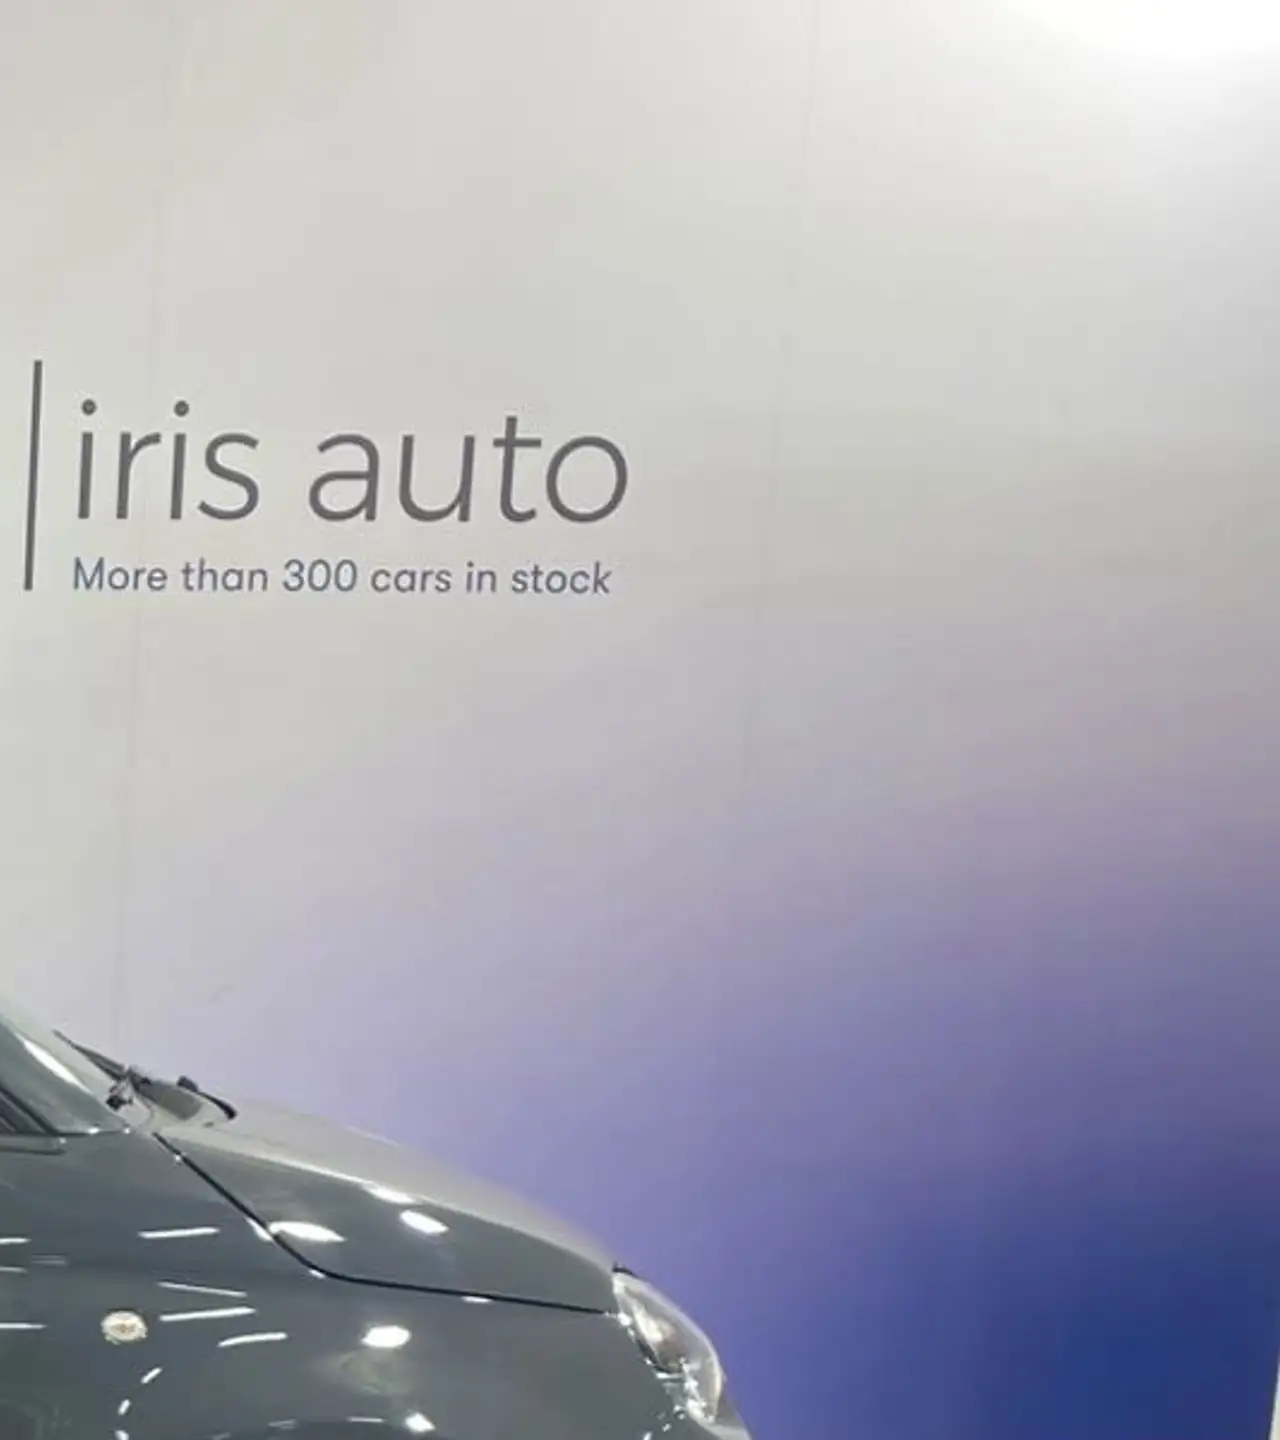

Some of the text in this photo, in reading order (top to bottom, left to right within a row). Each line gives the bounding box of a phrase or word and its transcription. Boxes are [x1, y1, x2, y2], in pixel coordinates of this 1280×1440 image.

[76, 398, 629, 525] iris auto
[72, 556, 613, 595] More than 300 cars in stock
